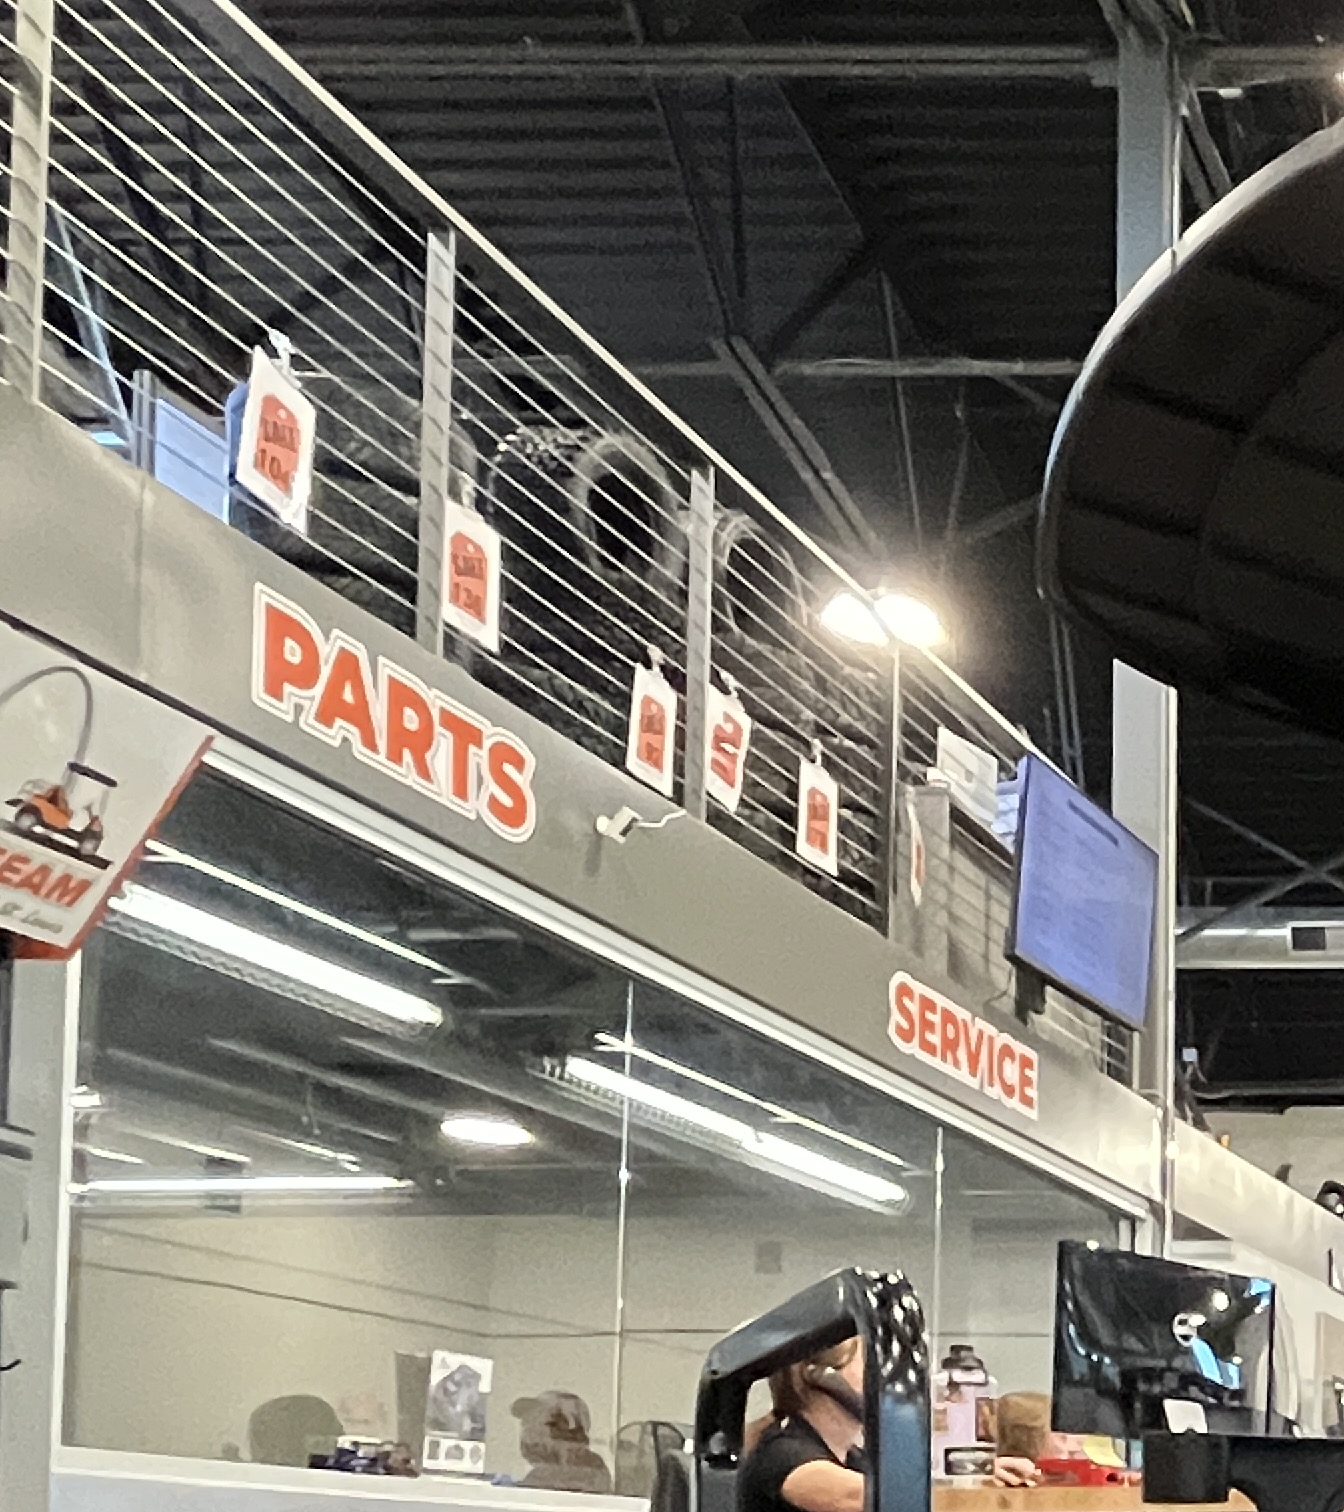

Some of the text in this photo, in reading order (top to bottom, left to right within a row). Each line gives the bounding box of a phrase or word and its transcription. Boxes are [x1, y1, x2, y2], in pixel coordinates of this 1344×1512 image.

[262, 600, 529, 831] PARTS
[0, 846, 94, 908] EAM
[893, 980, 1035, 1110] SERVICE
